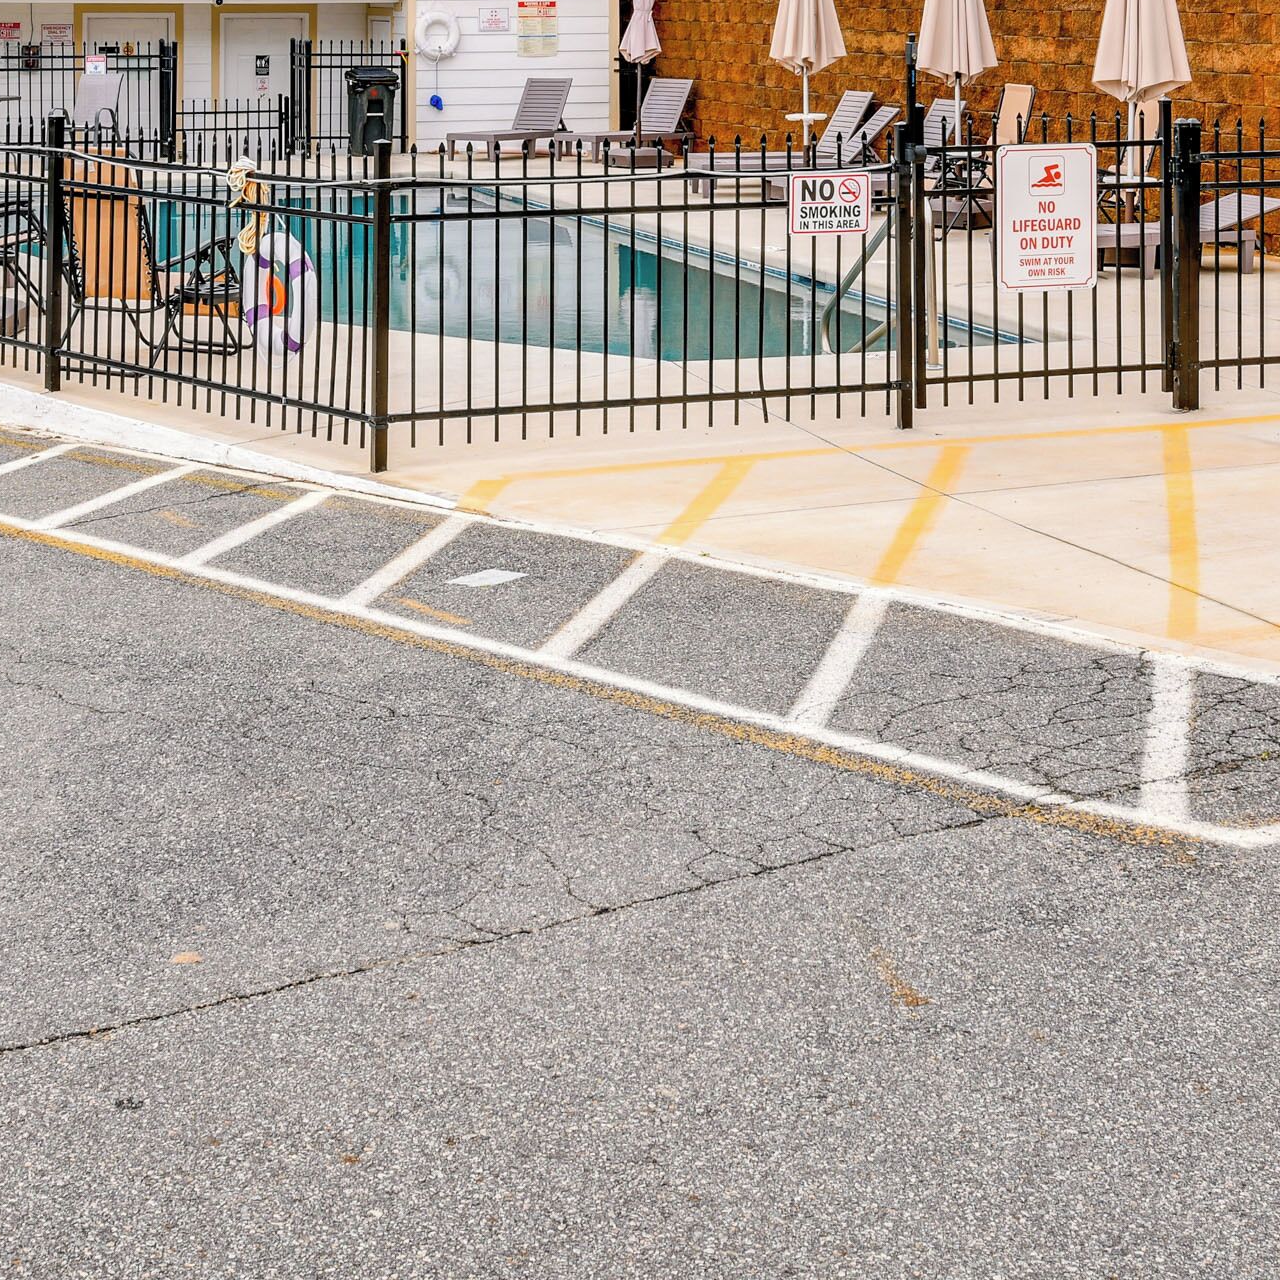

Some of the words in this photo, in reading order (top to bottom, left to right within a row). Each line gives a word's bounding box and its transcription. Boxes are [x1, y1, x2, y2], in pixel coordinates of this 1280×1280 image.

[801, 179, 835, 202] NO
[800, 205, 861, 219] SMOKING
[1038, 201, 1056, 214] NO
[799, 221, 810, 230] IN
[812, 220, 834, 230] THIS
[836, 219, 860, 229] AREA
[1012, 218, 1081, 233] LIFEGUARD
[1020, 237, 1037, 250] ON
[1041, 236, 1074, 249] DUTY
[1019, 258, 1041, 267] SWIM
[1042, 257, 1053, 265] AT
[1053, 256, 1074, 265] YOUR
[1028, 269, 1046, 277] OWN
[1047, 267, 1066, 276] RISK
